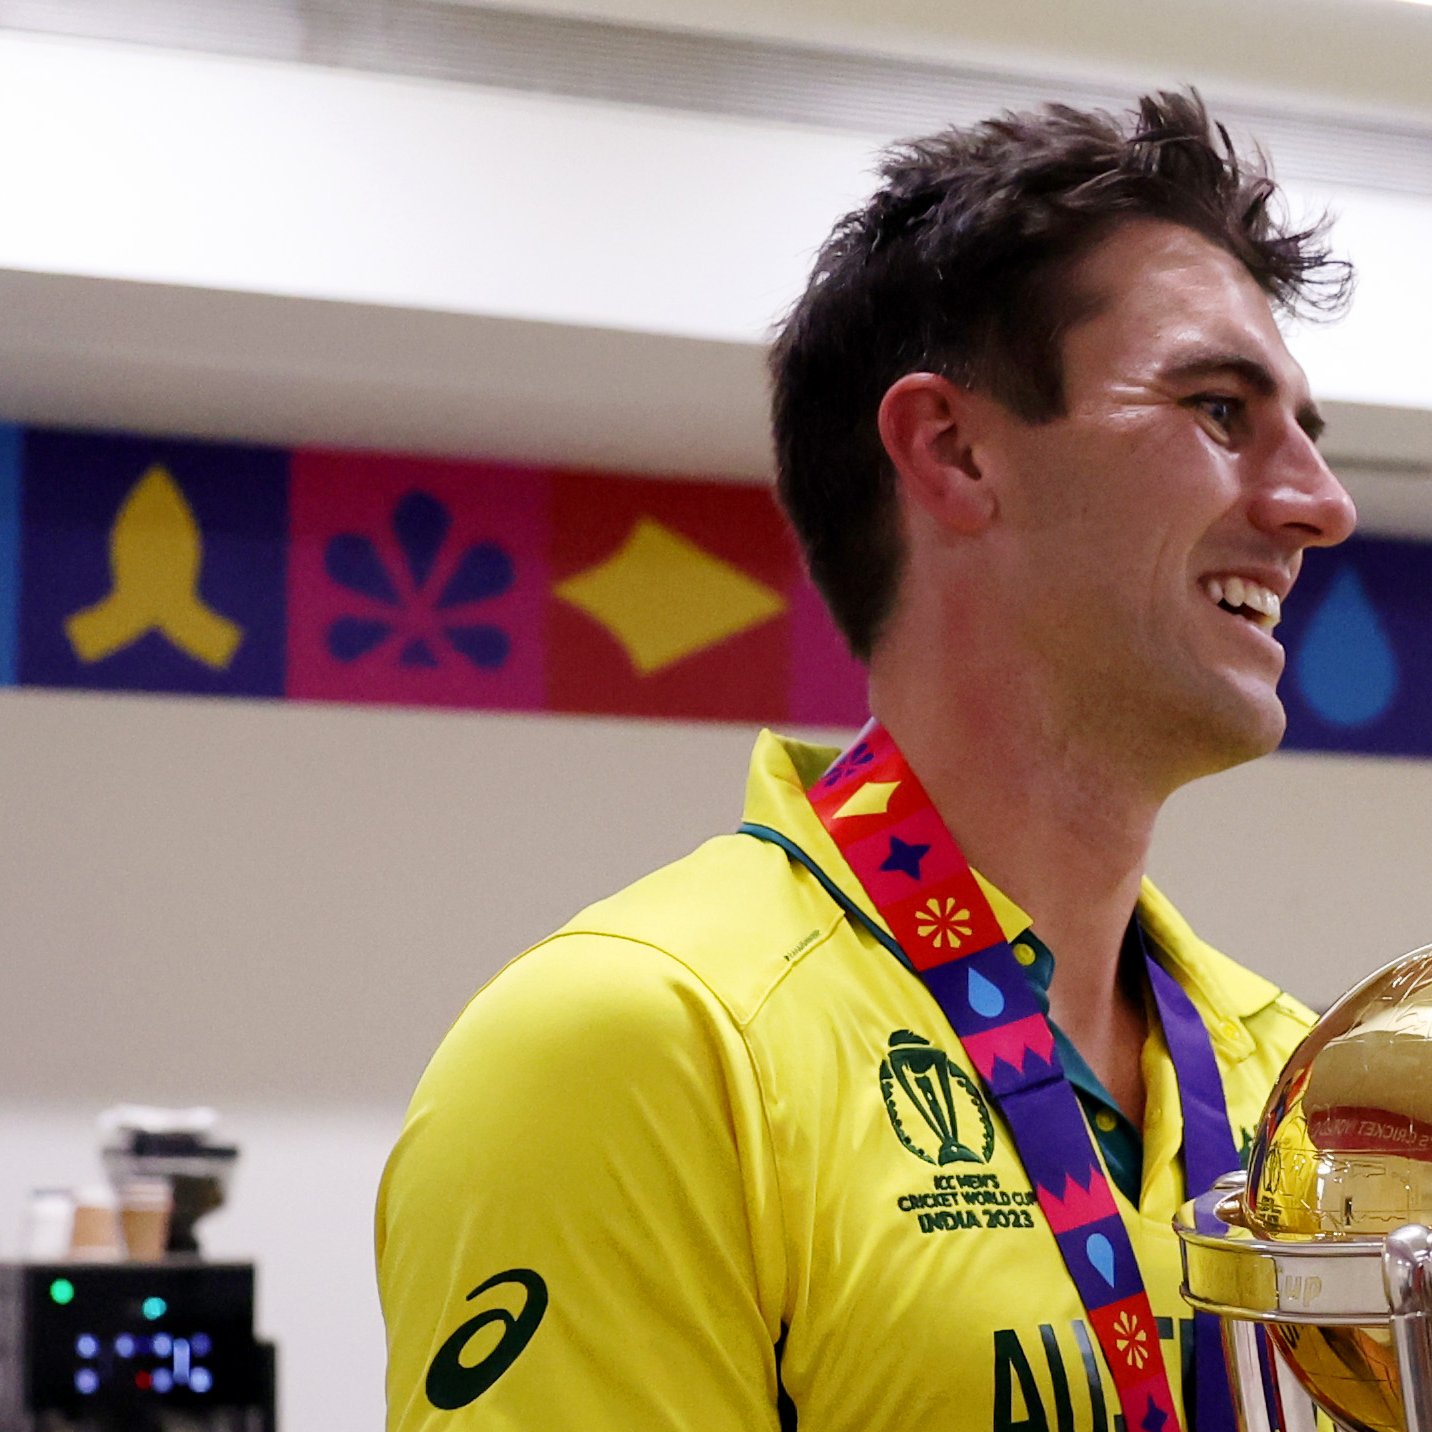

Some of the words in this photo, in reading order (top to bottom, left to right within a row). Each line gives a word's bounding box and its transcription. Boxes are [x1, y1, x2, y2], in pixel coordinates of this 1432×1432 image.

[898, 1191, 958, 1212] CRICKET
[961, 1190, 1011, 1206] WORLD
[917, 1209, 982, 1234] INDIA
[982, 1209, 1034, 1229] 2023
